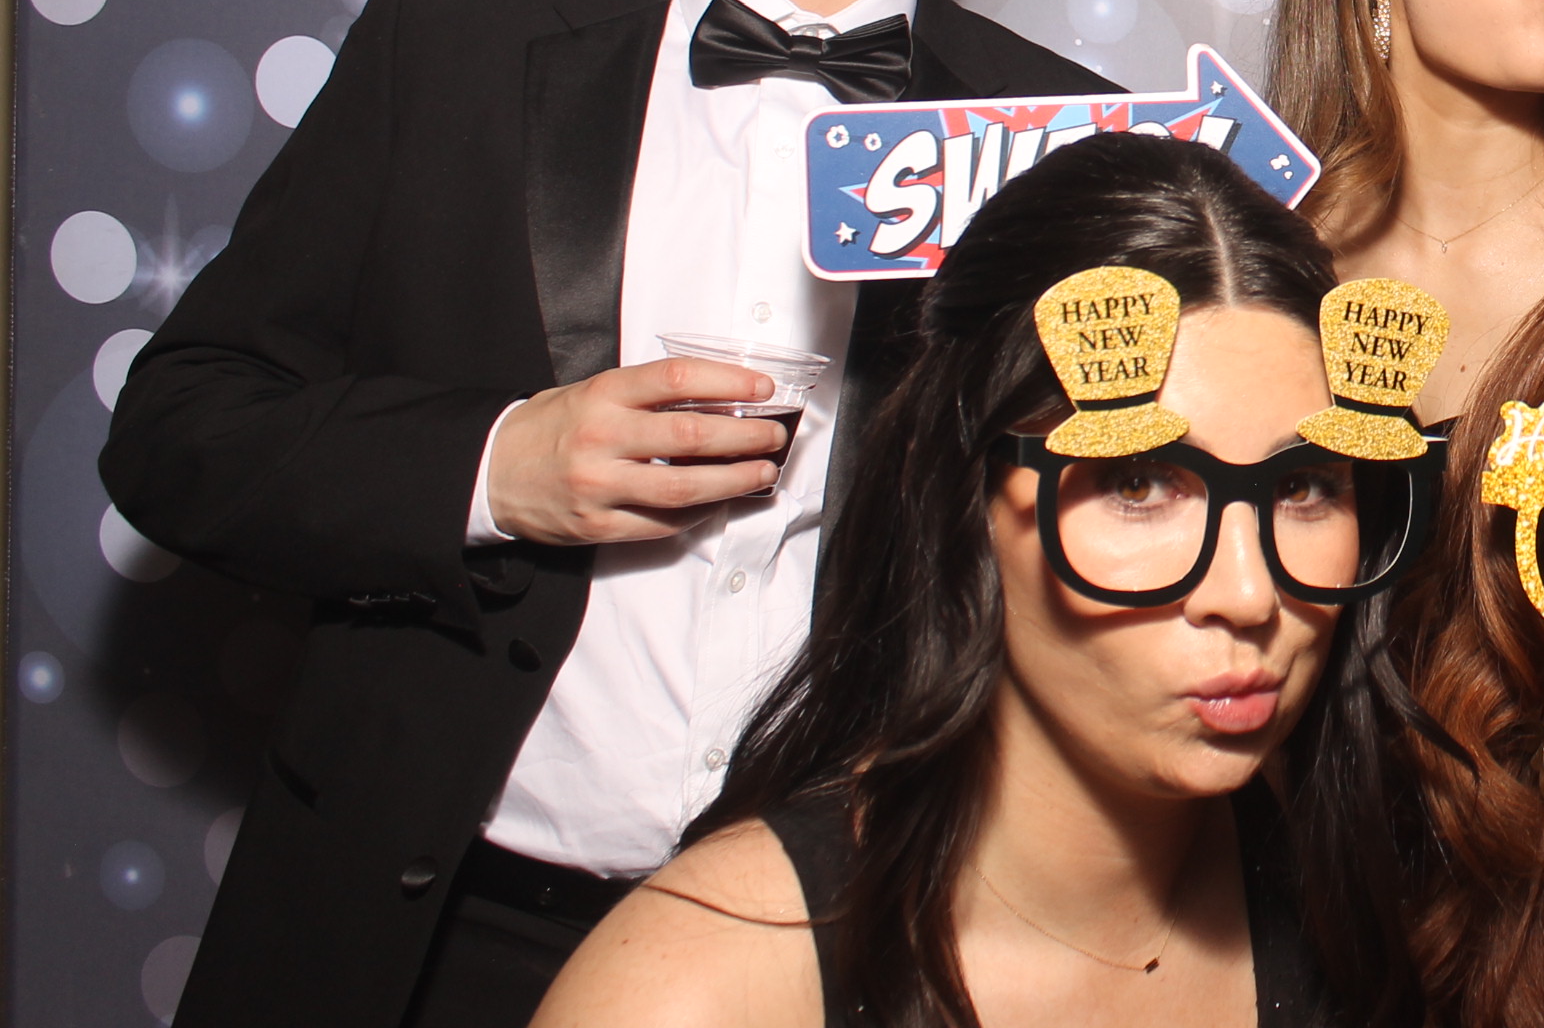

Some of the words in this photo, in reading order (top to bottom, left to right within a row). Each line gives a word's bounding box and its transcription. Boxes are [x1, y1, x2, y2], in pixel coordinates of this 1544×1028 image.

[1061, 293, 1155, 325] HAPPY
[1343, 300, 1431, 336] HAPPY
[1077, 324, 1146, 354] NEW
[1349, 331, 1415, 362] NEW
[1078, 356, 1152, 386] YEAR
[1343, 360, 1409, 392] YEAR
